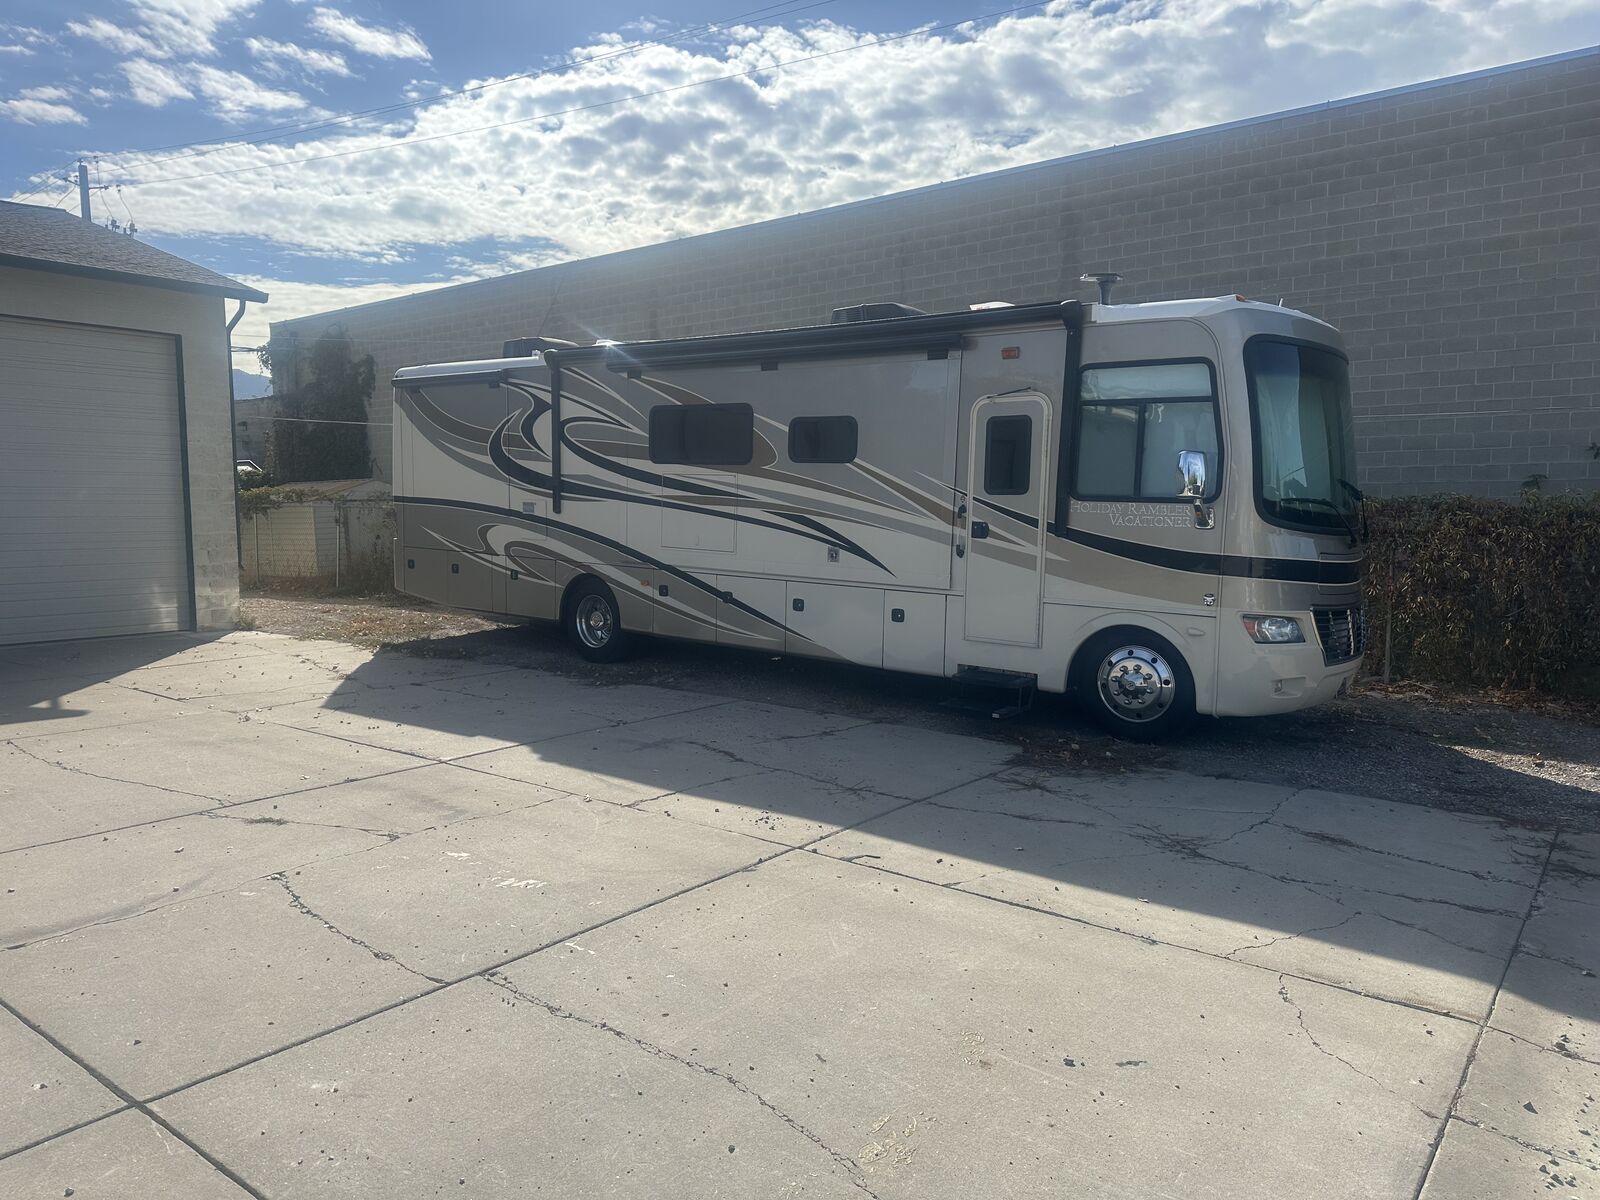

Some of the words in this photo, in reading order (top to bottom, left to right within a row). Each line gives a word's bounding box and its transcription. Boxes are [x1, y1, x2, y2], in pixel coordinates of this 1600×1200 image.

[1070, 501, 1123, 514] HOLIDAY
[1128, 502, 1192, 516] RAMBLER
[1110, 514, 1192, 528] VACATIONER
